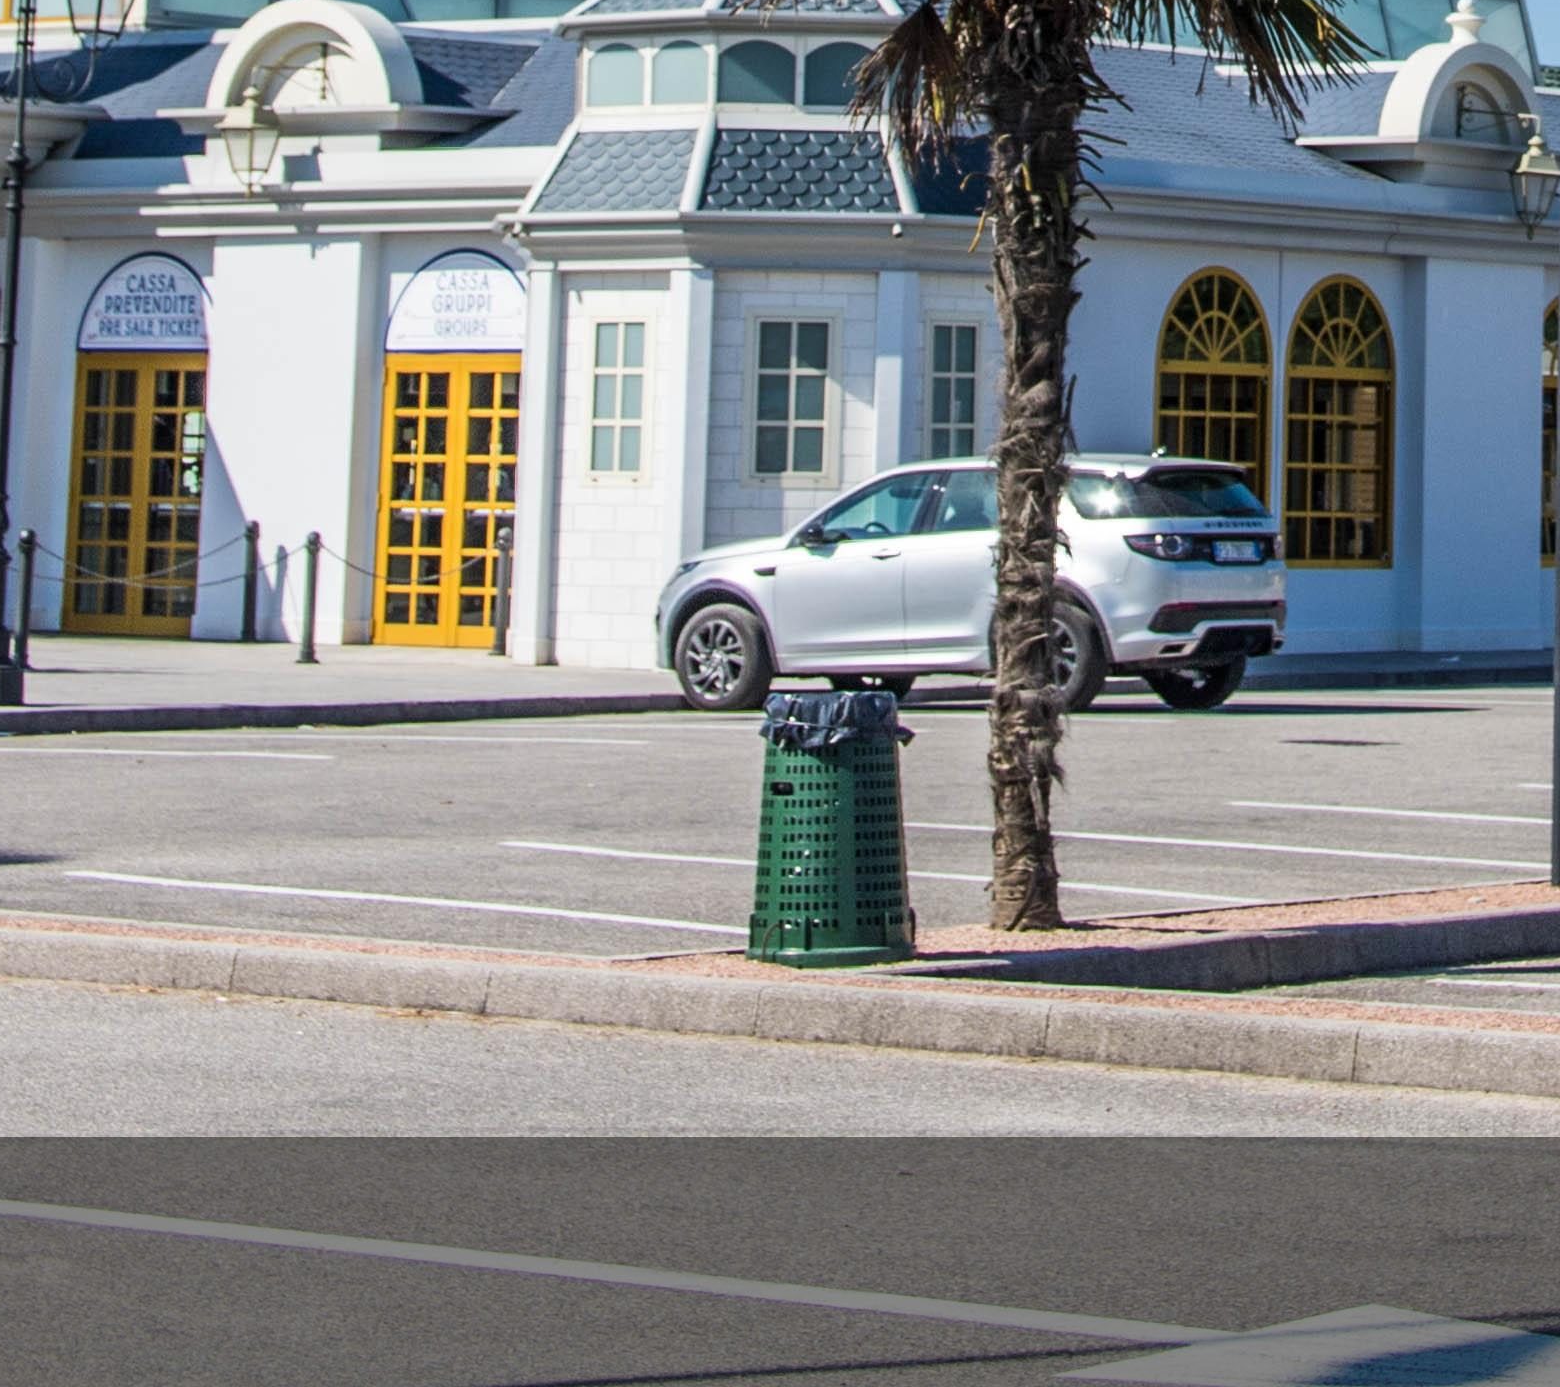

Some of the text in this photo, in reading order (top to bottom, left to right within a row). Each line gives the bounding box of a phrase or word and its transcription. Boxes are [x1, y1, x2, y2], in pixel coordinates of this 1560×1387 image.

[125, 274, 177, 293] CASSA
[436, 271, 489, 290] CASSA
[104, 294, 196, 315] PREVENDITE
[431, 293, 493, 313] GRUPPI
[99, 319, 200, 337] PRE SALE TICKET
[433, 318, 488, 336] GROUPS
